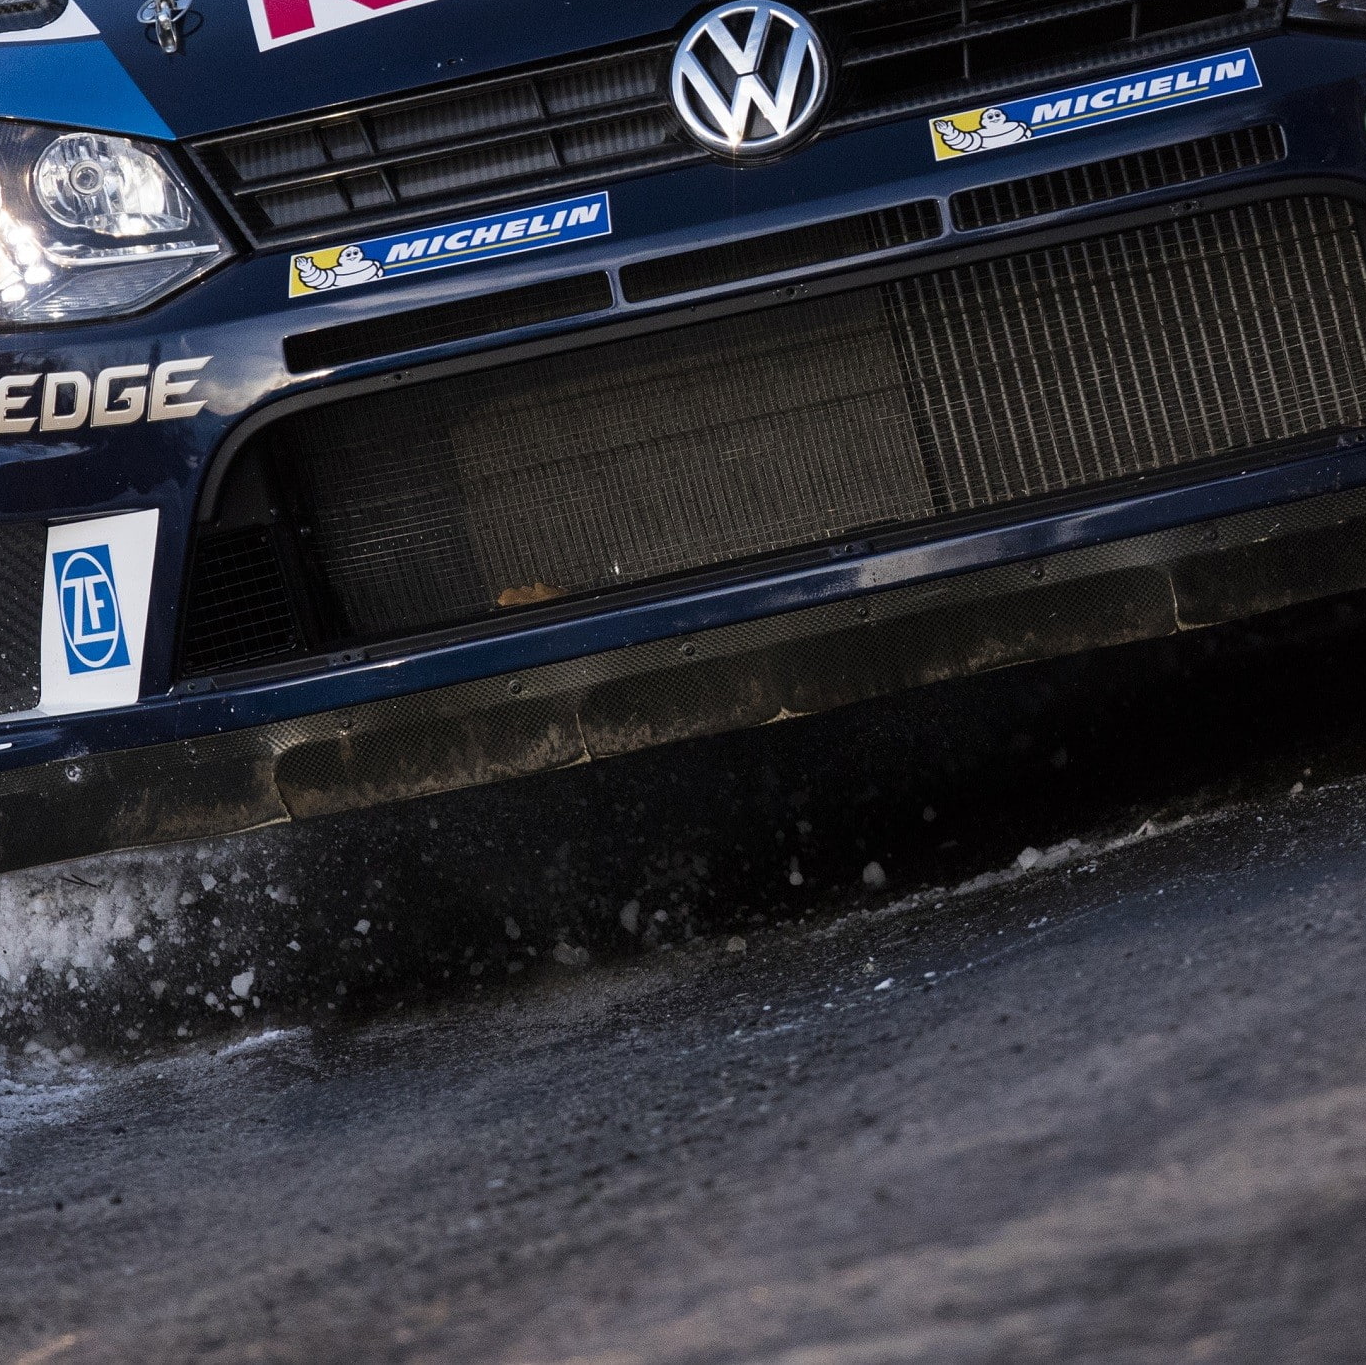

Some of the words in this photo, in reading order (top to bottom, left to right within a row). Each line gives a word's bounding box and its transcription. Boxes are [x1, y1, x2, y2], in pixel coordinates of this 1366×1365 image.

[1031, 59, 1246, 124] MICHELIN
[385, 202, 603, 264] MICHELIN
[62, 573, 116, 646] ZF
